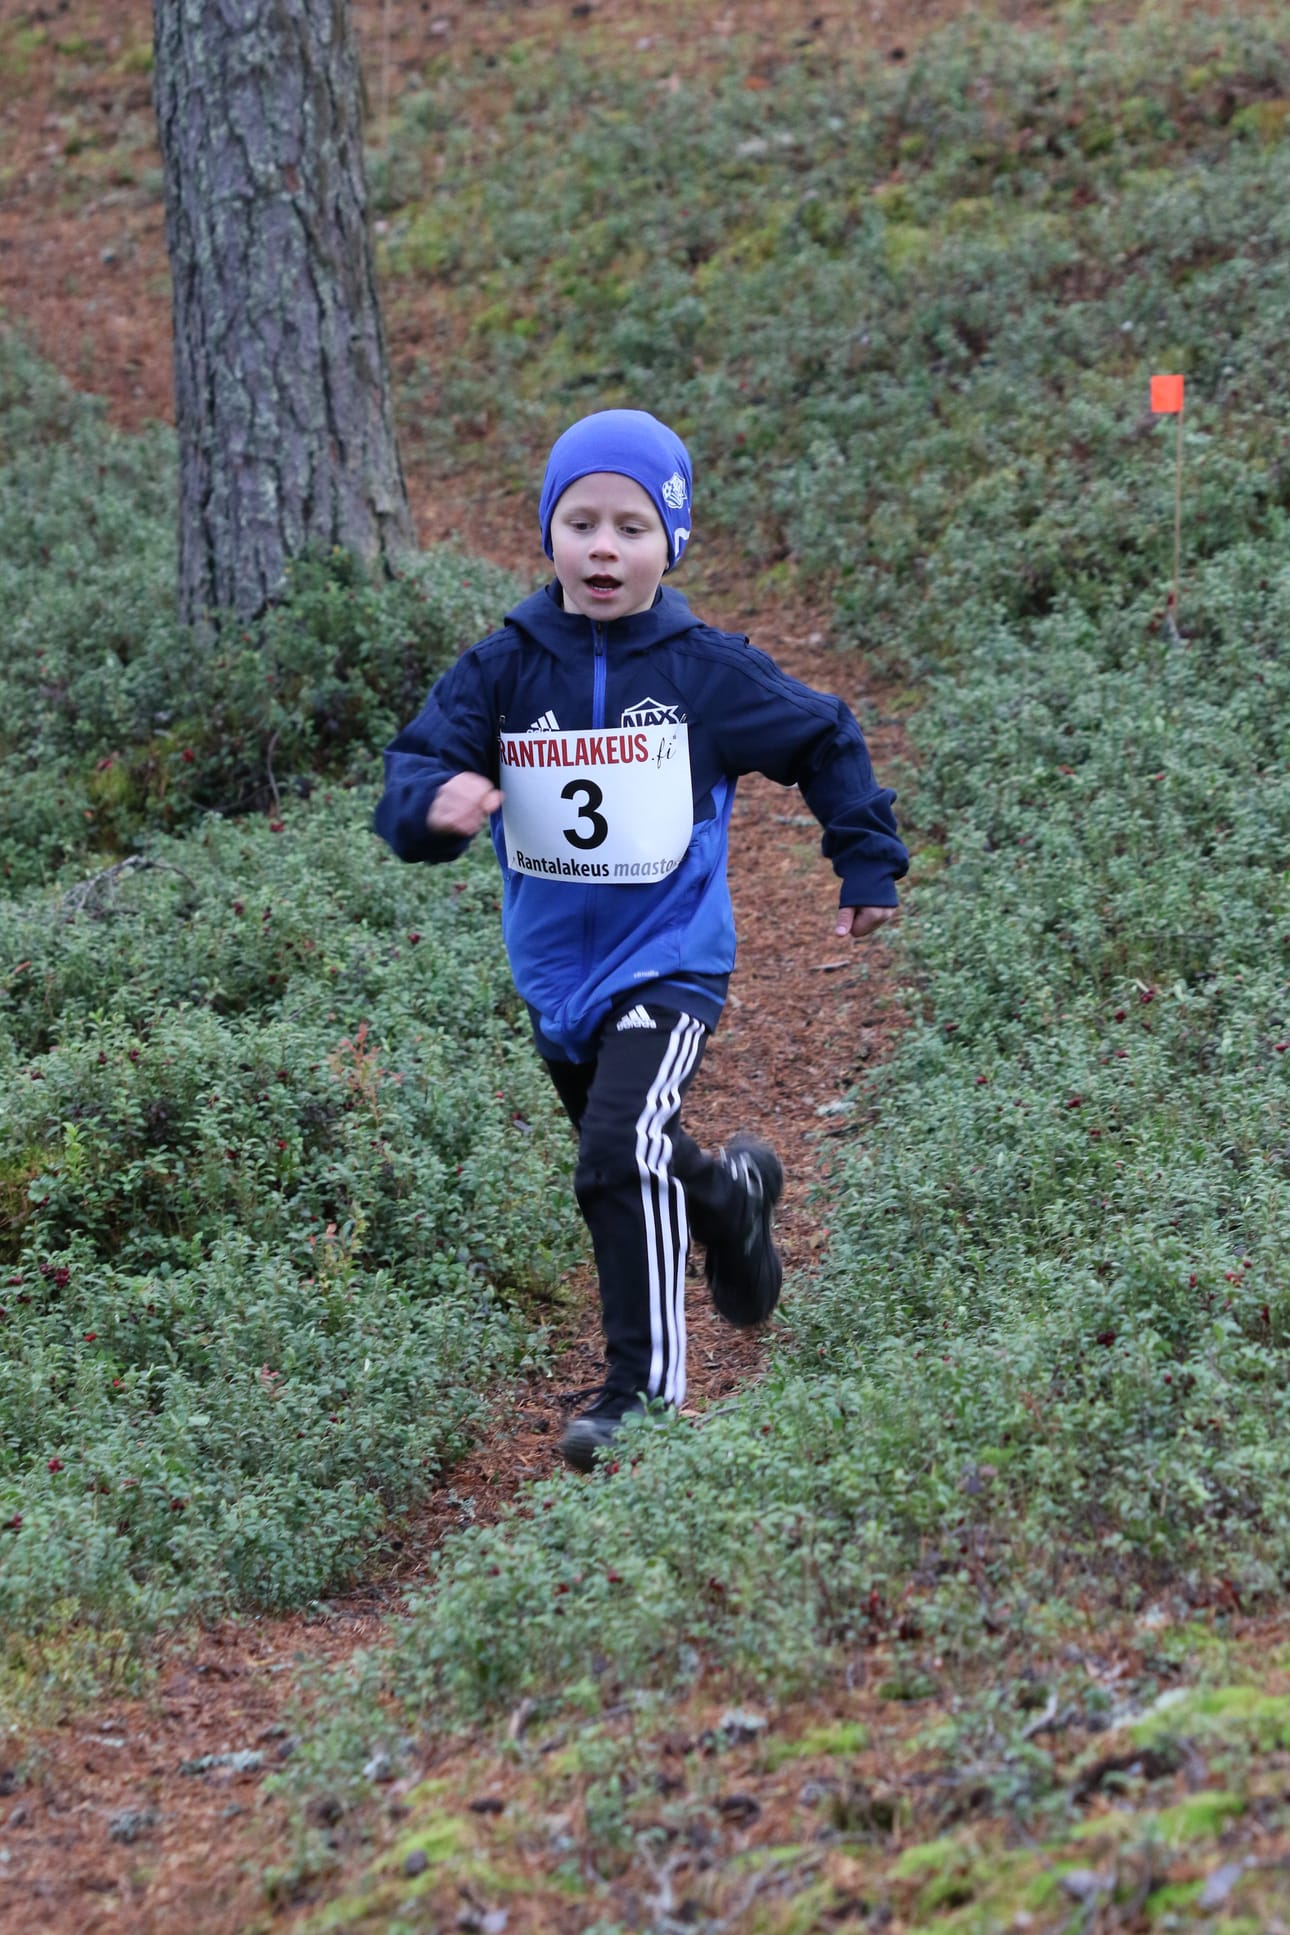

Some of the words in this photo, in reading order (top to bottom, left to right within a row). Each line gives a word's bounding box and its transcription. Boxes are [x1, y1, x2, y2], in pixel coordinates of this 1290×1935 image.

[560, 778, 609, 850] 3
[516, 850, 610, 877] Rantalakeus
[613, 858, 679, 877] maasto
